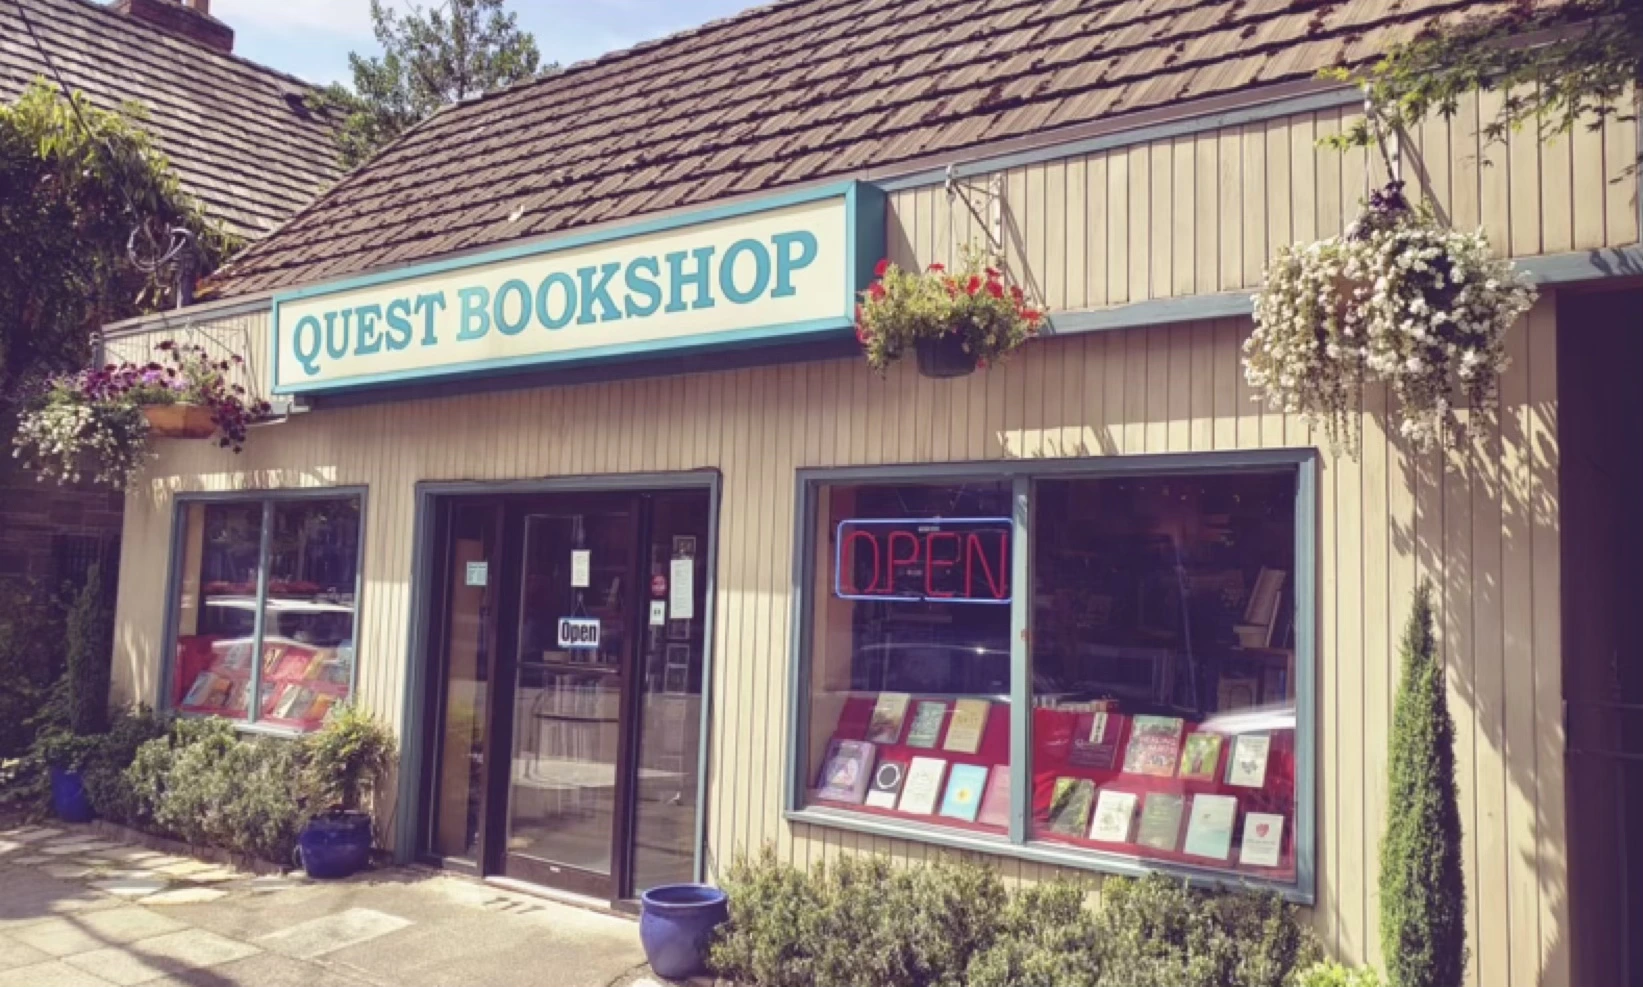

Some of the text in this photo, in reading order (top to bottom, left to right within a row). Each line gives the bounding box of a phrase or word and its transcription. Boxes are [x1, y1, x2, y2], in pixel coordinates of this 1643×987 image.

[292, 230, 818, 374] QUEST BOOKSHOP
[841, 530, 1008, 598] OPEN
[561, 620, 597, 643] Open
